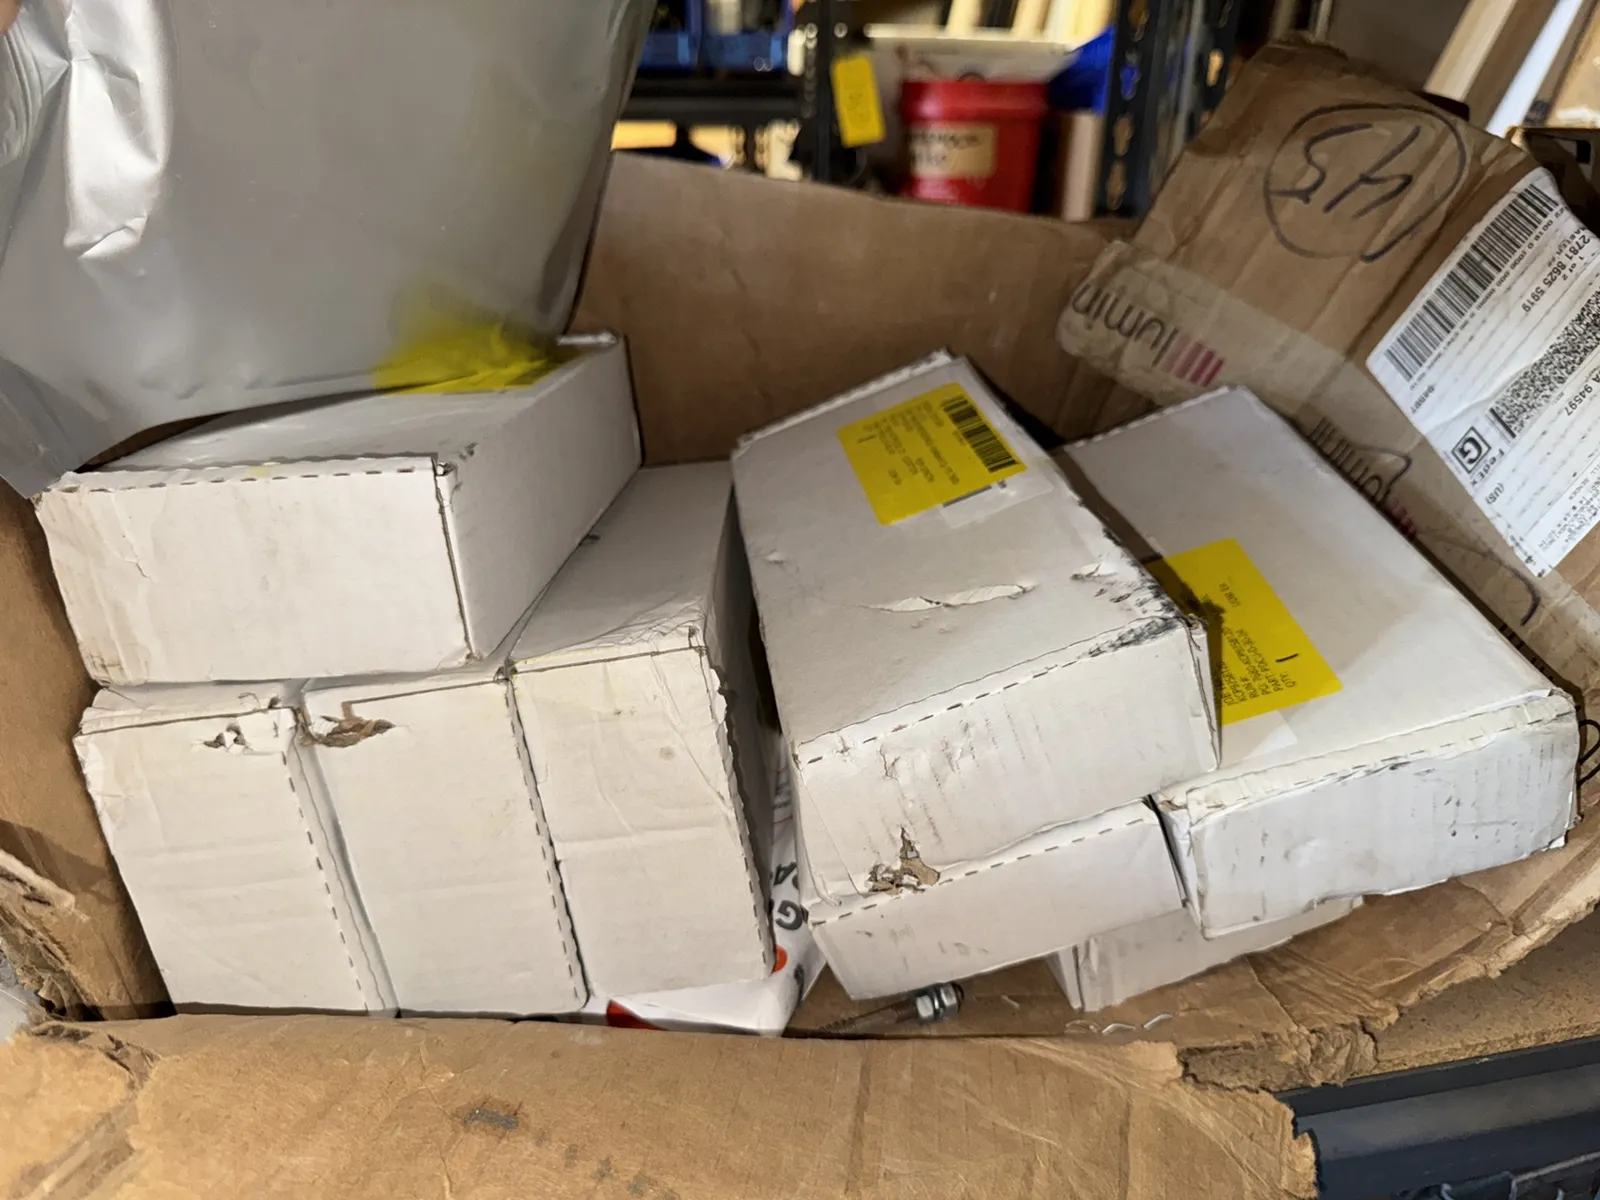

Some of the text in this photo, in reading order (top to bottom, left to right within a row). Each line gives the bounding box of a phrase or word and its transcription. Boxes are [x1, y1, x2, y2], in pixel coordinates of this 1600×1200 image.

[1269, 122, 1422, 220] 45
[1521, 234, 1591, 313] 2781 8625 5919
[1561, 273, 1569, 281] 2
[1564, 383, 1593, 417] 94597
[1458, 436, 1483, 465] G
[1470, 448, 1505, 486] FedEx
[1485, 483, 1505, 505] (US)
[1243, 683, 1260, 699] RUN
